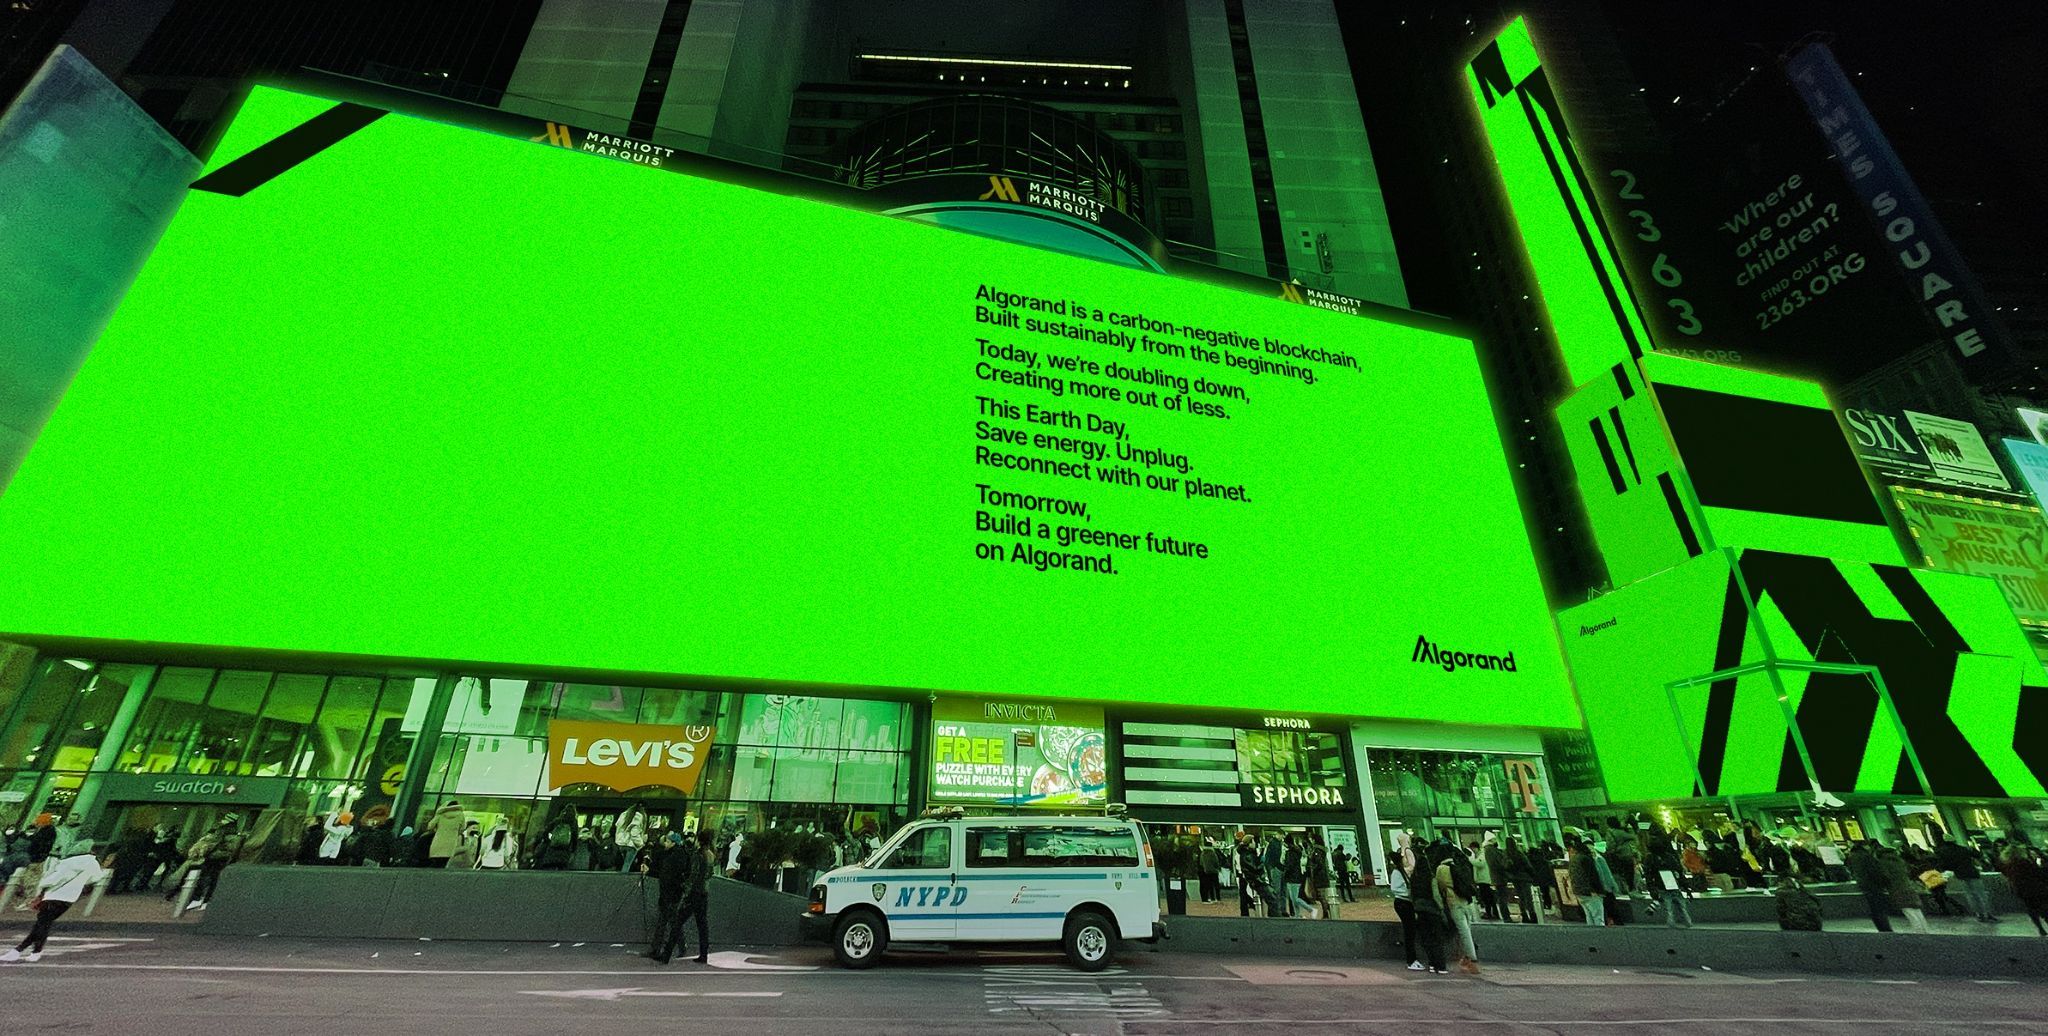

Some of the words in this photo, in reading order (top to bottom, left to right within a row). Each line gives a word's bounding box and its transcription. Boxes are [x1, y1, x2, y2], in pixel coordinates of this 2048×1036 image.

[583, 143, 660, 166] MARQUIS
[586, 131, 675, 158] MARRIOTT
[1029, 182, 1106, 213] MARRIOTT
[1029, 194, 1098, 221] MARQUIS
[1722, 174, 1802, 234] Where
[1736, 226, 1774, 258] are
[1776, 192, 1815, 229] our
[1736, 203, 1840, 287] children?
[1760, 278, 1790, 302] FIND
[1791, 256, 1820, 281] OUT
[1822, 244, 1840, 262] AT
[1872, 190, 1987, 358] SQUARE
[1307, 288, 1362, 308] MARRIOTT
[1309, 298, 1358, 316] MARQUIS
[1755, 252, 1866, 331] 2363.ORG
[975, 283, 1067, 316] Algorand
[1071, 301, 1088, 320] is
[1092, 308, 1104, 323] a
[1108, 312, 1260, 352] carbon-negative
[1263, 337, 1363, 374] blockchain,
[975, 305, 1020, 330] Built
[1025, 318, 1138, 353] sustainably
[1140, 334, 1186, 359] from
[1189, 344, 1221, 365] the
[1224, 349, 1319, 385] beginning.
[975, 337, 1042, 371] Today,
[1046, 354, 1100, 376] we're
[1104, 361, 1190, 395] doubling
[1193, 376, 1251, 405] down,
[975, 361, 1064, 397] Creating
[1069, 380, 1121, 402] more
[1125, 390, 1159, 409] out
[1163, 394, 1183, 412] of
[1186, 396, 1231, 420] less.
[975, 395, 1021, 421] This
[1026, 403, 1082, 430] Earth
[1086, 413, 1131, 442] Day,
[975, 420, 1028, 446] Save
[1032, 433, 1111, 462] energy.
[1115, 441, 1194, 475] Unplug.
[975, 445, 1092, 481] Reconnect
[1095, 464, 1141, 488] with
[1145, 474, 1180, 493] our
[1184, 477, 1252, 503] planet.
[975, 483, 1092, 523] Tomorrow,
[975, 510, 1031, 537] Build
[1037, 523, 1051, 540] a
[1056, 525, 1142, 551] greener
[1145, 531, 1209, 559] future
[975, 542, 1005, 562] on
[1010, 542, 1119, 575] Algorand.
[1579, 616, 1618, 637] Algorand
[1411, 634, 1517, 673] Algorand
[984, 702, 1057, 721] INVICTA
[1263, 717, 1311, 729] SEPHORA
[937, 726, 956, 737] GET
[956, 727, 967, 737] A
[935, 736, 1005, 764] FREE
[153, 779, 225, 794] swatch
[935, 763, 974, 775] PUZZLE
[974, 764, 1002, 776] WITH
[1002, 765, 1033, 777] EVERY
[935, 773, 972, 786] WATCH
[1253, 786, 1344, 805] SEPHORA
[894, 886, 968, 908] NYPD
